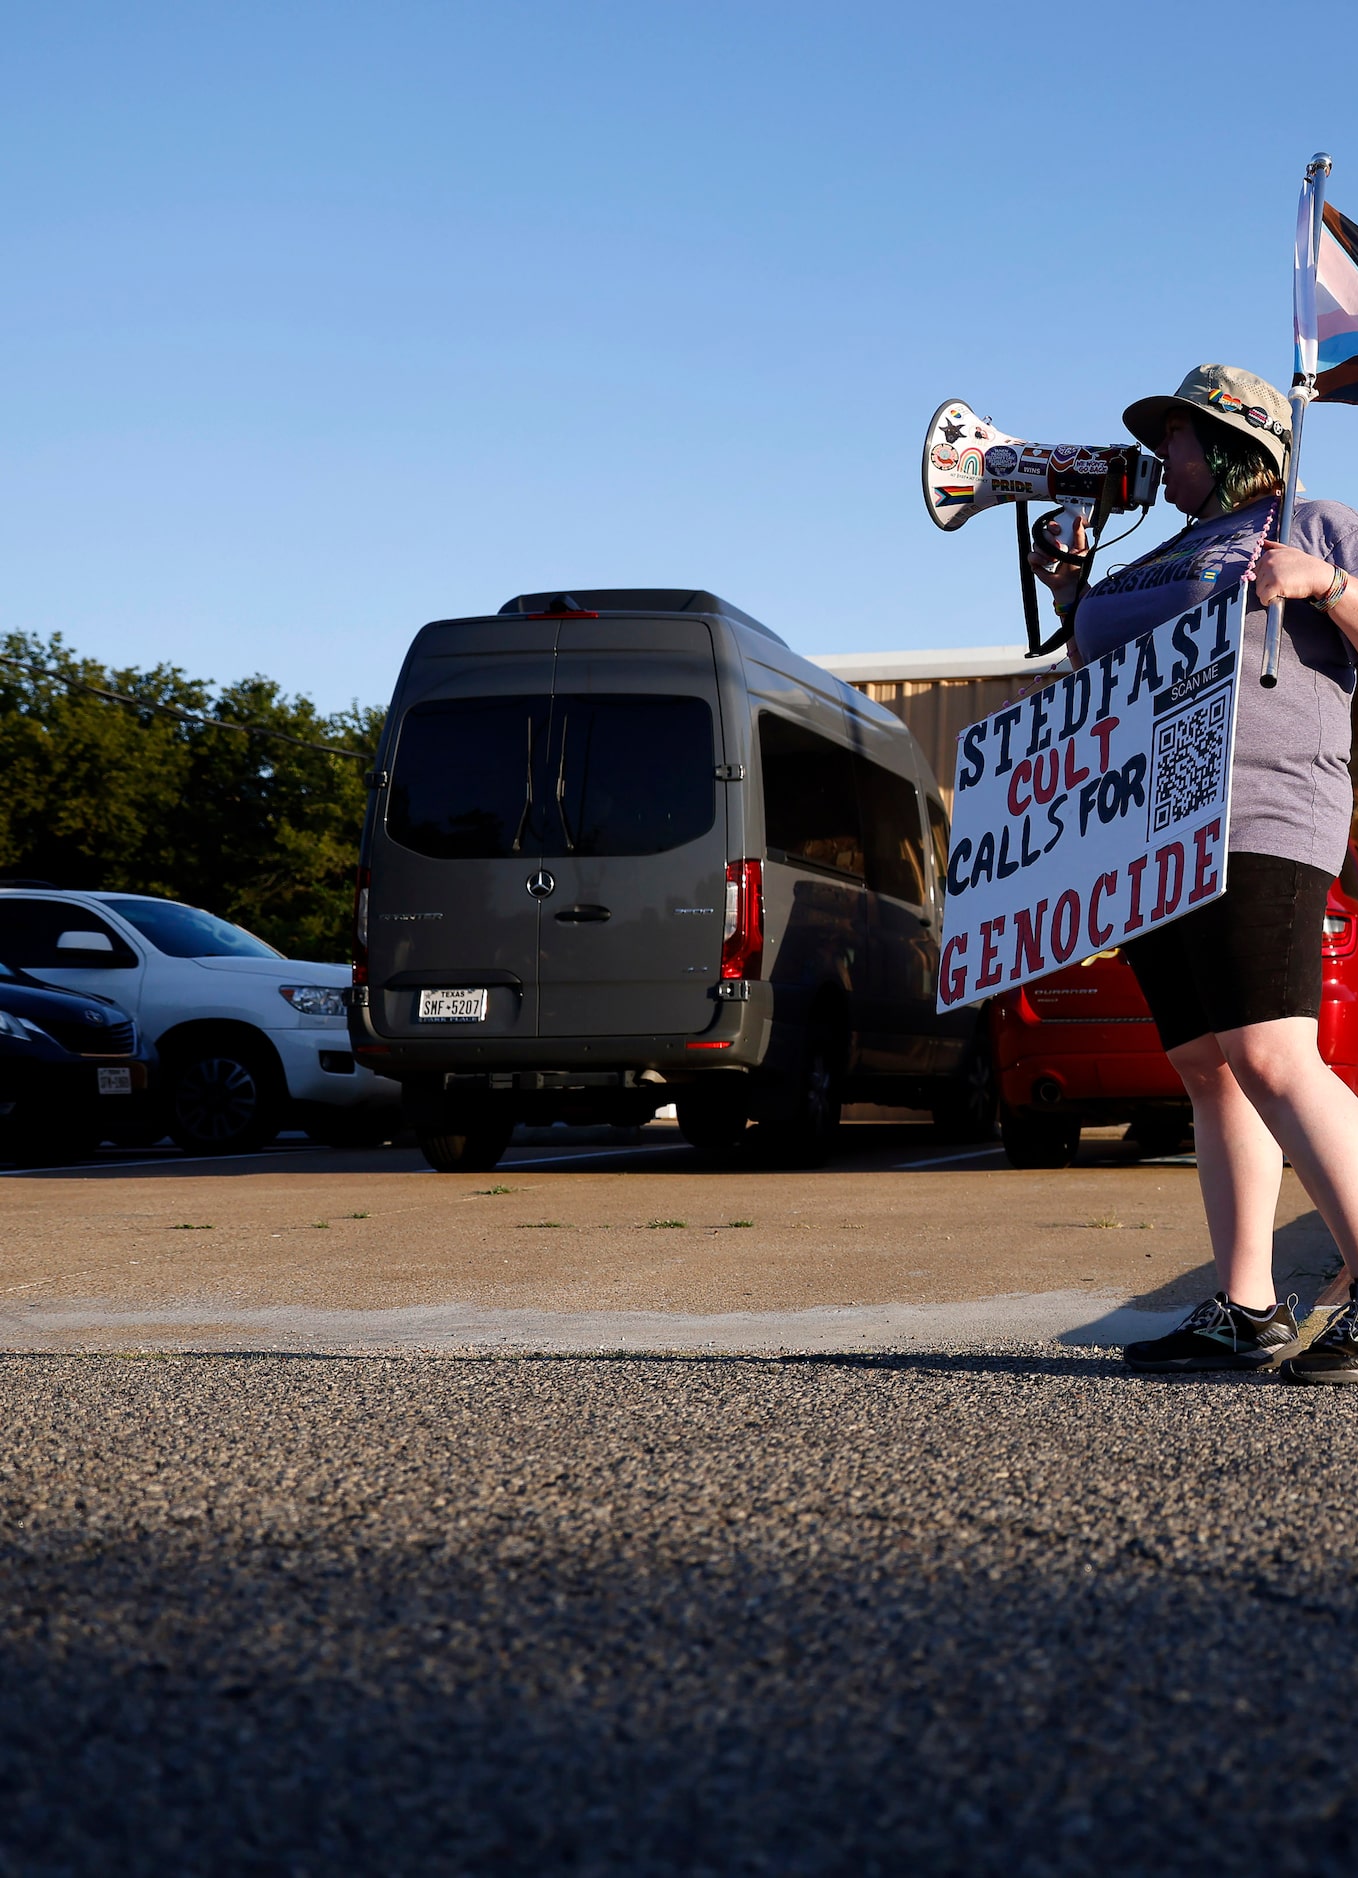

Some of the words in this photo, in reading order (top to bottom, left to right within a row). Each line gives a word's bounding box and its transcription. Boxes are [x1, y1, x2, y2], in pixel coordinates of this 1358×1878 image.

[991, 479, 1033, 494] PRIDE
[1023, 466, 1041, 475] WINS
[959, 588, 1239, 791] STEDFAST
[1170, 674, 1201, 702] SCAN
[1202, 663, 1219, 684] ME
[1007, 717, 1120, 817] CULT
[948, 792, 1073, 896] CALLS
[1079, 752, 1148, 837] FOR
[940, 816, 1221, 1006] GENOCIDE
[451, 1000, 480, 1015] 5207
